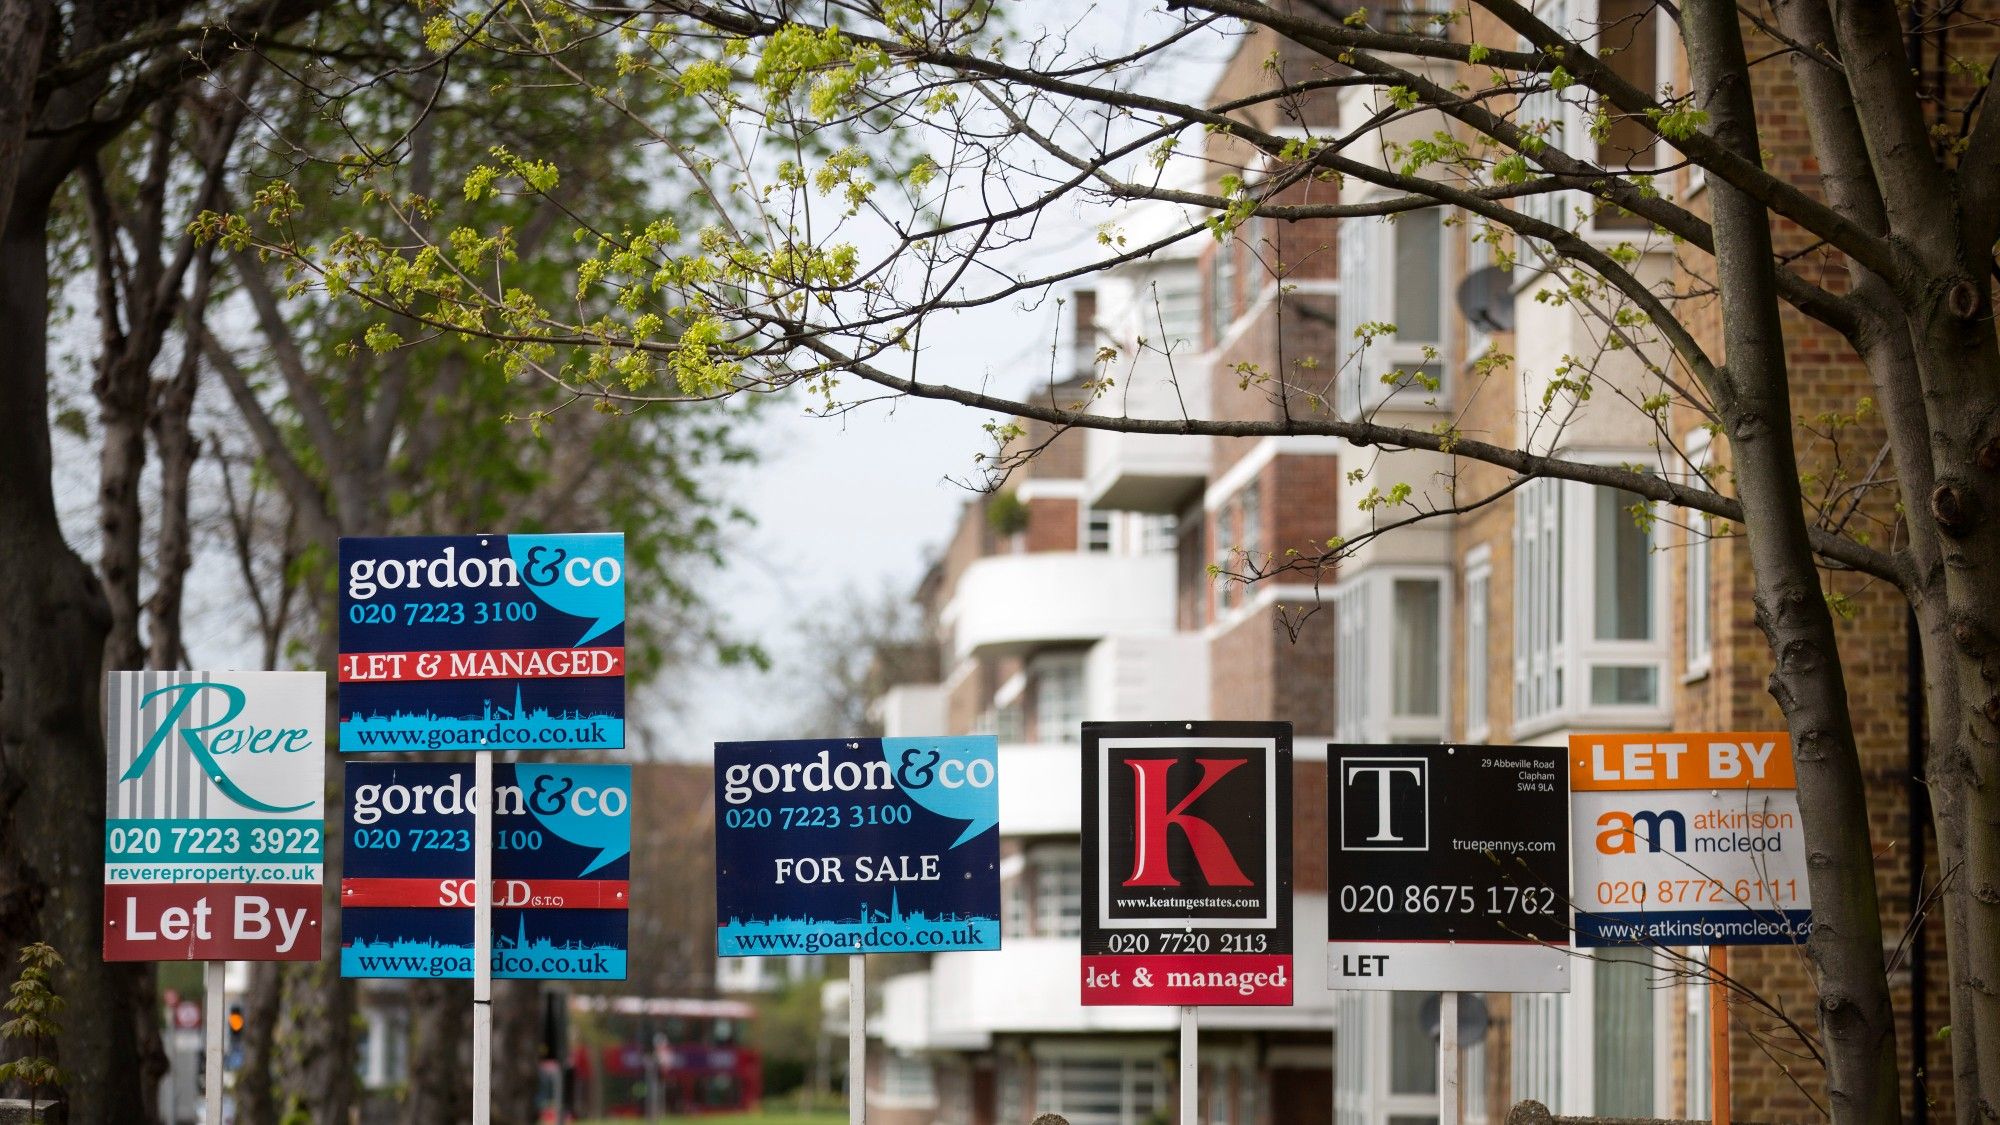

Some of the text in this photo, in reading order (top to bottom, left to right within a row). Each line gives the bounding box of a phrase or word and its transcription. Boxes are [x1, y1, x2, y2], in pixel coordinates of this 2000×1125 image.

[349, 545, 622, 600] gordon&co
[350, 601, 537, 626] 020 7223 3100
[349, 650, 614, 680] LET & MANAGED
[119, 682, 316, 813] Revere
[358, 723, 607, 749] www.goandco.co.uk
[1481, 758, 1555, 769] 29 Abbeville Road
[1592, 742, 1776, 781] LET BY
[724, 748, 994, 805] gordon&co
[1517, 782, 1554, 792] SW4 9LA
[1518, 771, 1555, 781] Clapham
[725, 804, 912, 830] 020 7223 3100
[1348, 767, 1421, 841] T
[1122, 758, 1254, 887] K
[1595, 809, 1687, 855] am
[1694, 809, 1793, 829] atkinson
[109, 827, 320, 854] 020 7223 3922
[354, 829, 543, 852] 020 7223 100
[1452, 838, 1556, 853] truepennys.com
[1695, 832, 1781, 852] mcleod
[110, 865, 315, 883] revereproperty.co.uk
[775, 855, 941, 884] FOR SALE
[531, 896, 564, 907] (S.T.C)
[1117, 897, 1260, 910] www.keatingestates.com
[1340, 884, 1555, 914] 020 8675 1762
[1597, 879, 1796, 904] 020 8772 6111
[126, 895, 307, 953] Let By
[735, 926, 983, 953] www.goandco.co.uk
[1108, 934, 1267, 953] 020 7720 2113
[360, 953, 609, 976] www.goadco.co.uk
[1343, 955, 1389, 977] LET
[1088, 965, 1285, 996] let & managed
